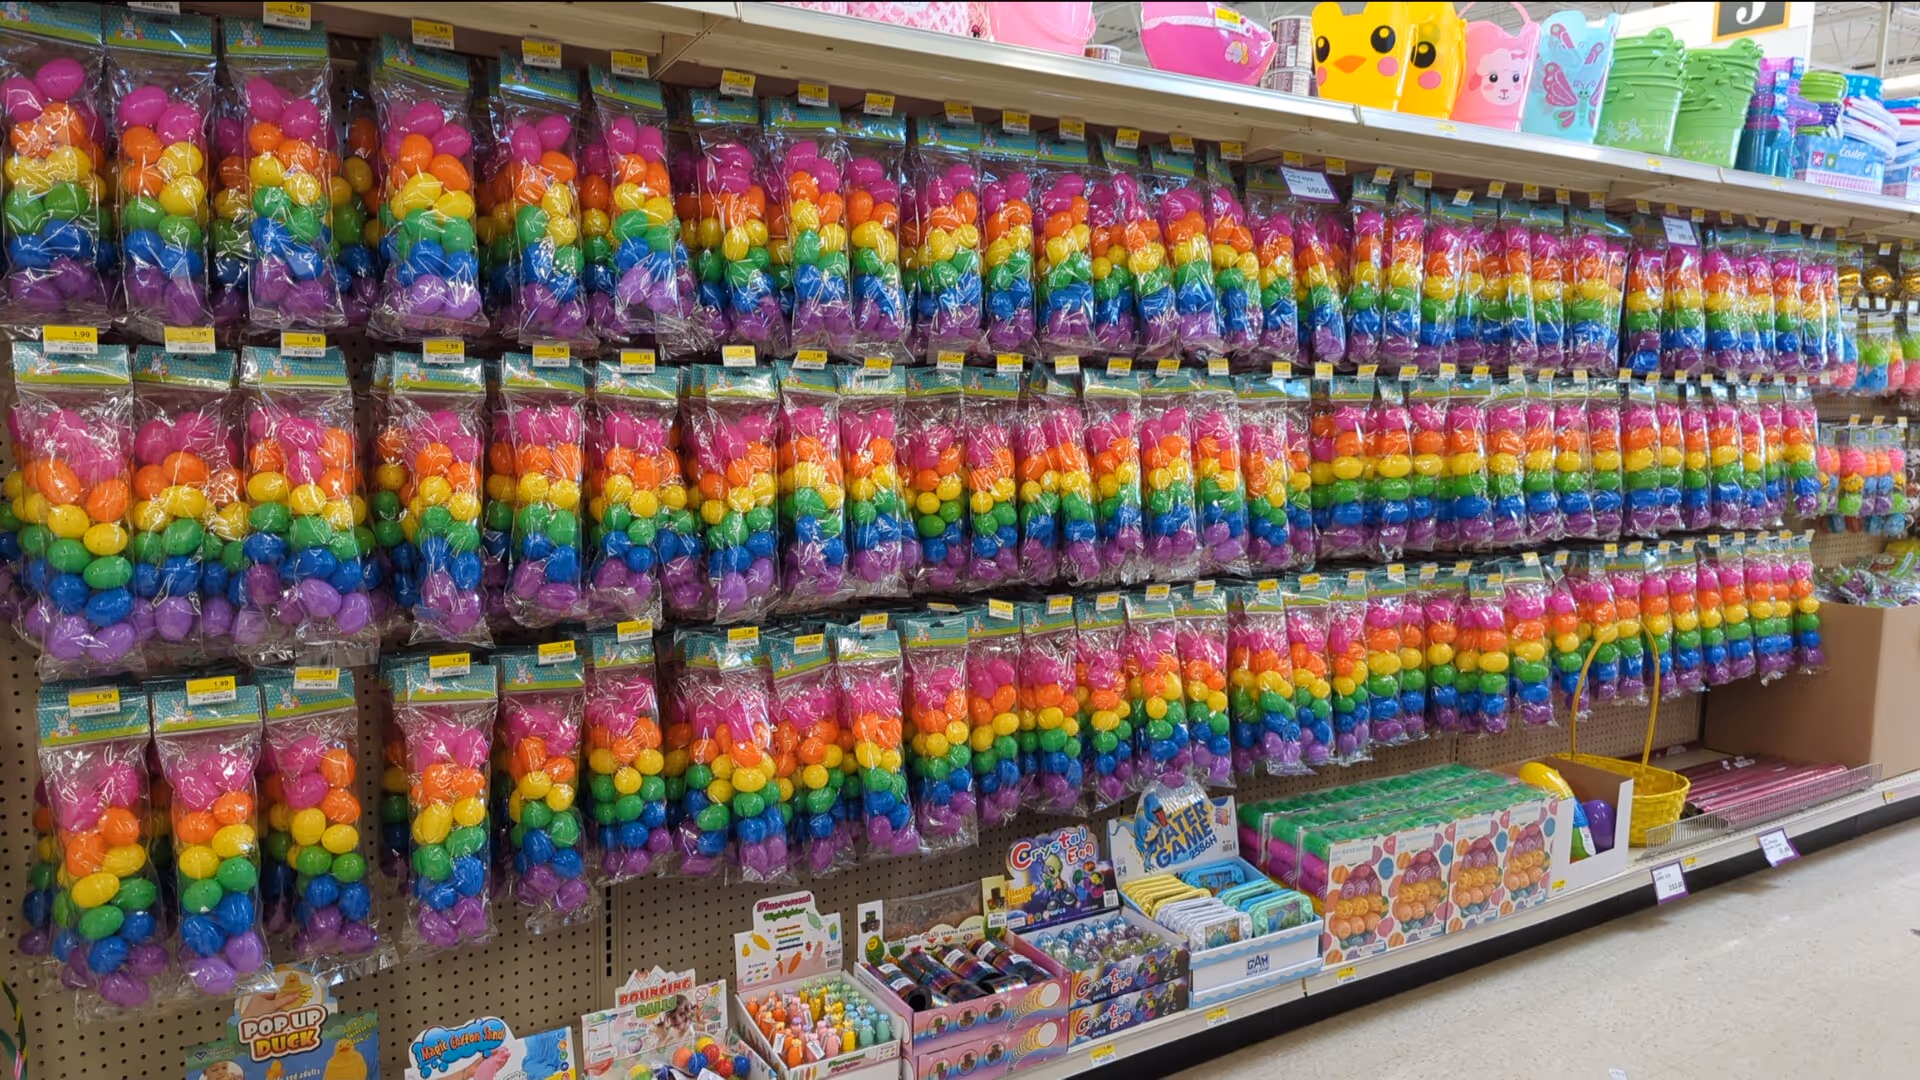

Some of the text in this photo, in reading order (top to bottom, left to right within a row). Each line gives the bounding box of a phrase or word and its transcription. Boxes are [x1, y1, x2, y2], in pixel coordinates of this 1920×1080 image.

[289, 5, 305, 14] 1.99
[96, 693, 112, 701] 1.99
[1011, 826, 1087, 870] Crystal
[1156, 819, 1212, 868] GAME
[1189, 835, 1217, 859] 2586H
[1117, 866, 1127, 877] 24
[619, 977, 691, 1006] BOUNCING
[1075, 963, 1131, 999] Crystal
[635, 994, 678, 1018] BALLS
[1075, 998, 1130, 1036] Crystal
[243, 1013, 288, 1039] POP
[290, 1008, 323, 1030] UP
[254, 1029, 316, 1058] DUCK
[421, 1026, 505, 1060] Magic Cotton Sand
[299, 1068, 321, 1079] adults
